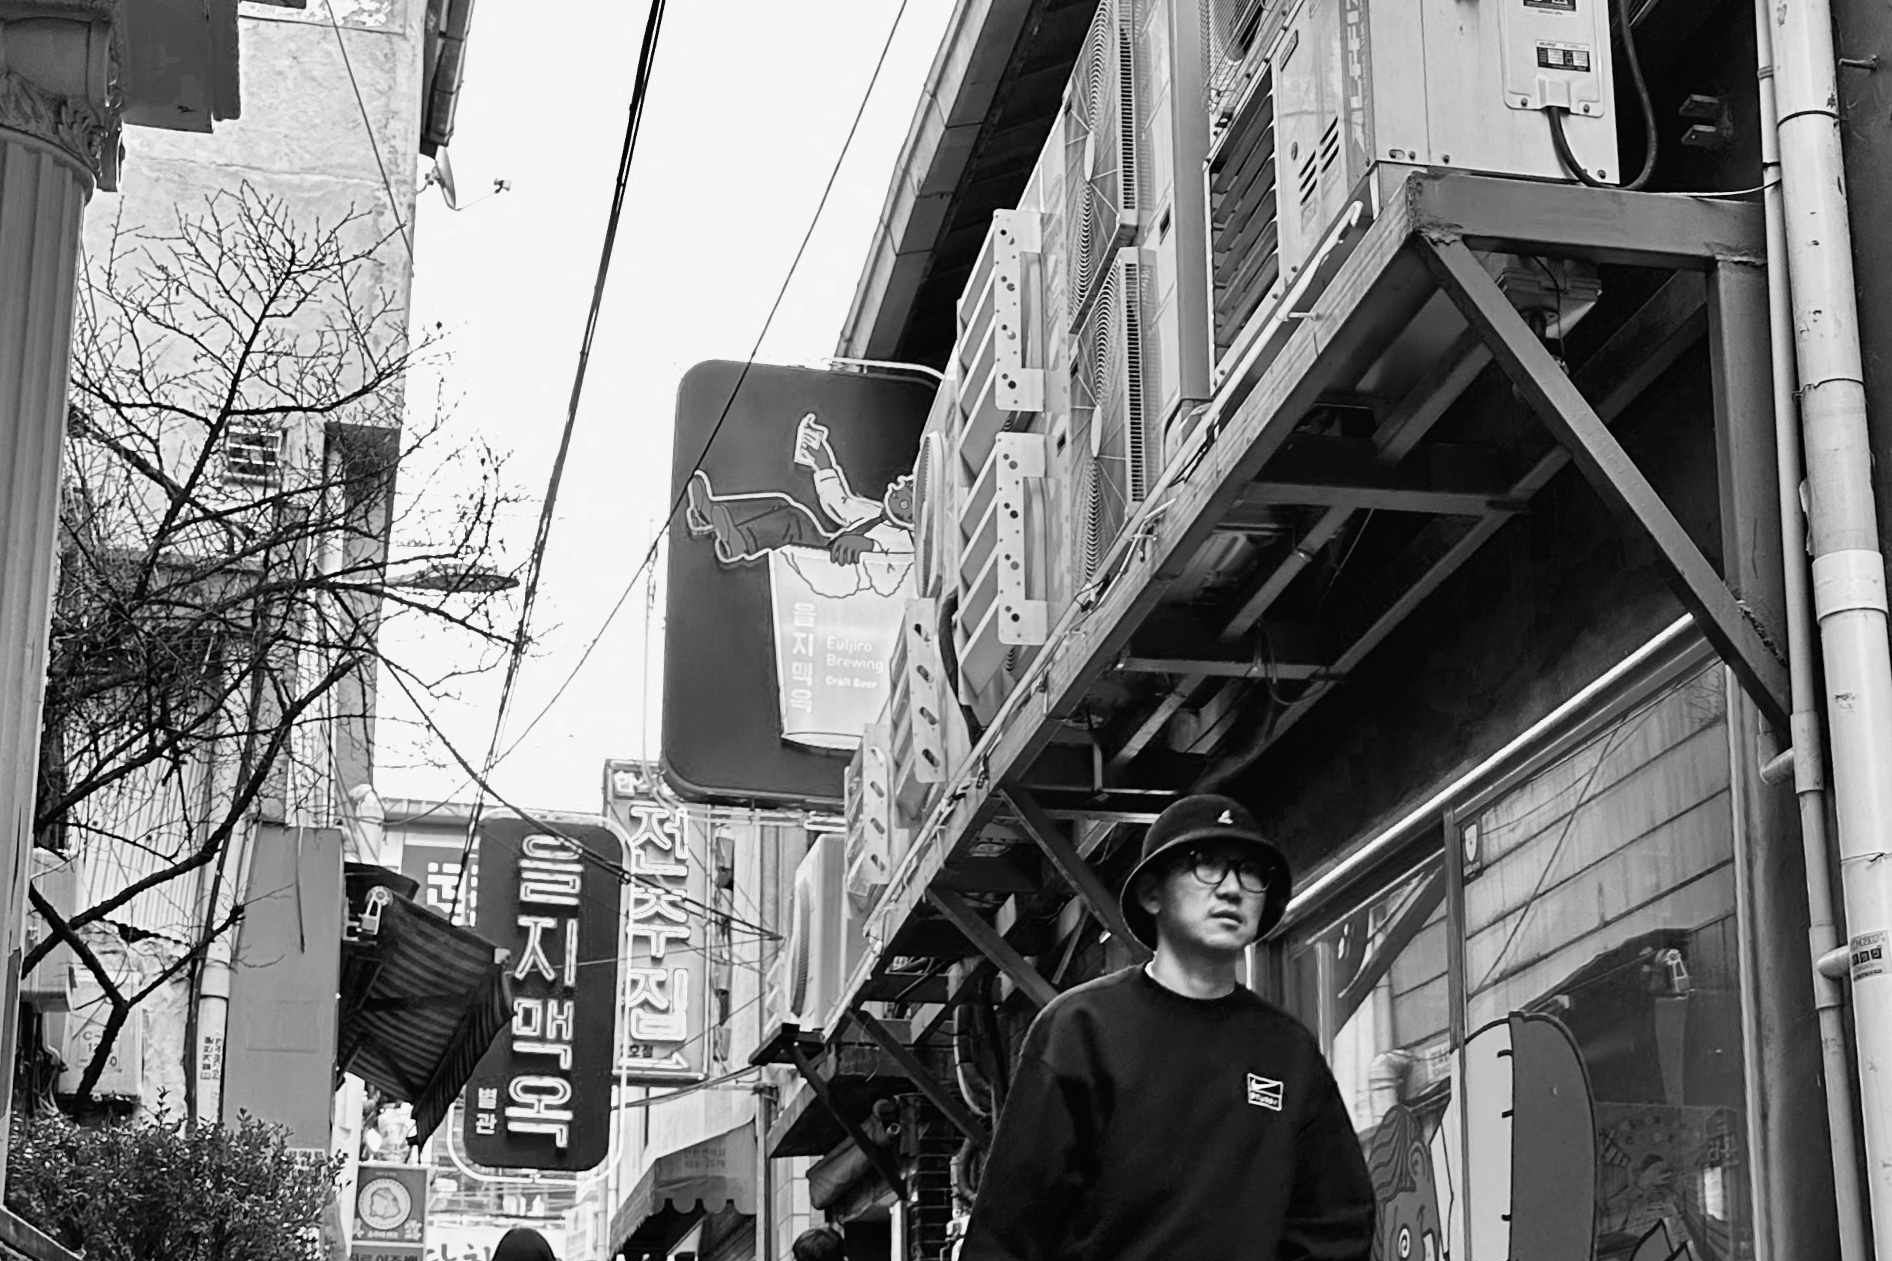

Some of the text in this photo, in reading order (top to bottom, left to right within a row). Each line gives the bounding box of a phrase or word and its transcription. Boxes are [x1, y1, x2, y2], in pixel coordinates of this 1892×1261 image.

[790, 602, 816, 714] 을지맥옥
[826, 635, 873, 655] Euljiro
[826, 653, 884, 674] Brewing
[626, 802, 692, 1041] 전주집
[504, 834, 585, 1148] 을지맥옥
[475, 1087, 498, 1135] 별관
